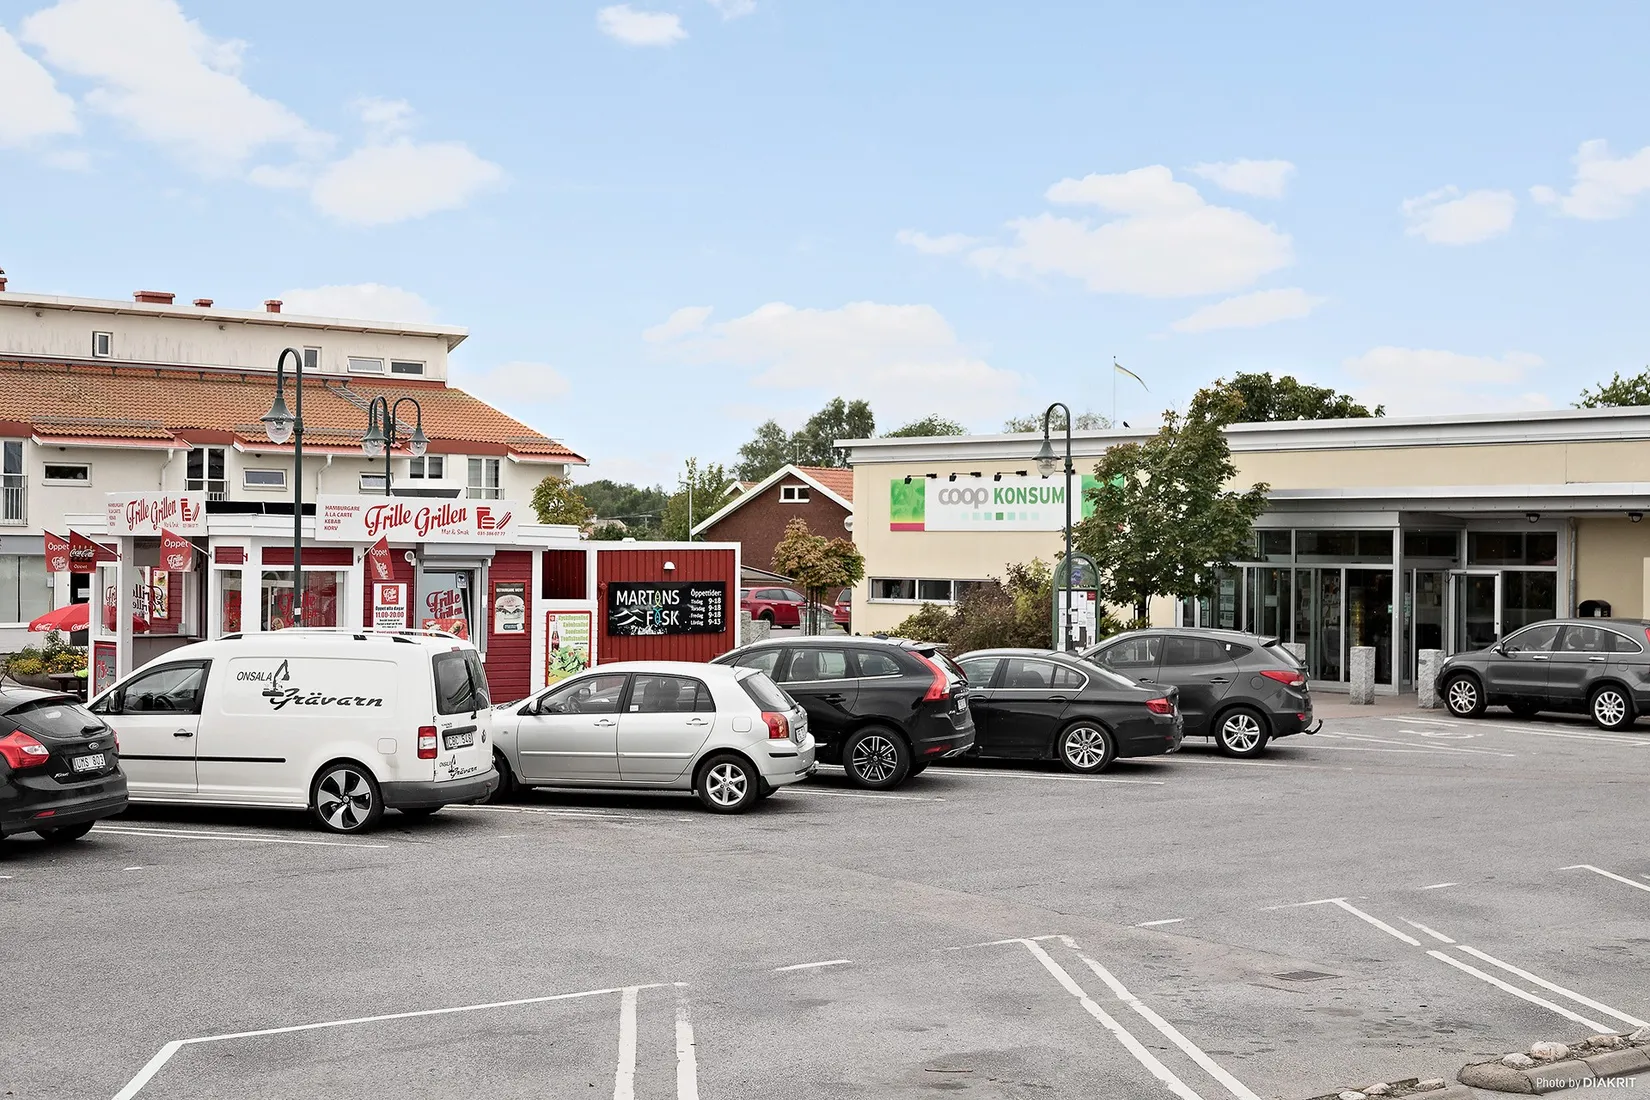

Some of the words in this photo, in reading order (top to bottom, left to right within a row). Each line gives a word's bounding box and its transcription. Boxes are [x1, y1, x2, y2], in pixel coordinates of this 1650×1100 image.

[937, 487, 989, 509] coop
[994, 486, 1065, 505] KONSUM
[126, 498, 149, 531] Frille
[150, 496, 177, 531] Grillen
[365, 503, 413, 537] Frille
[414, 503, 467, 537] Grillen
[164, 538, 189, 549] Öppet
[426, 589, 461, 613] Frille
[236, 671, 273, 681] ONSALA
[270, 688, 383, 710] Grävarn
